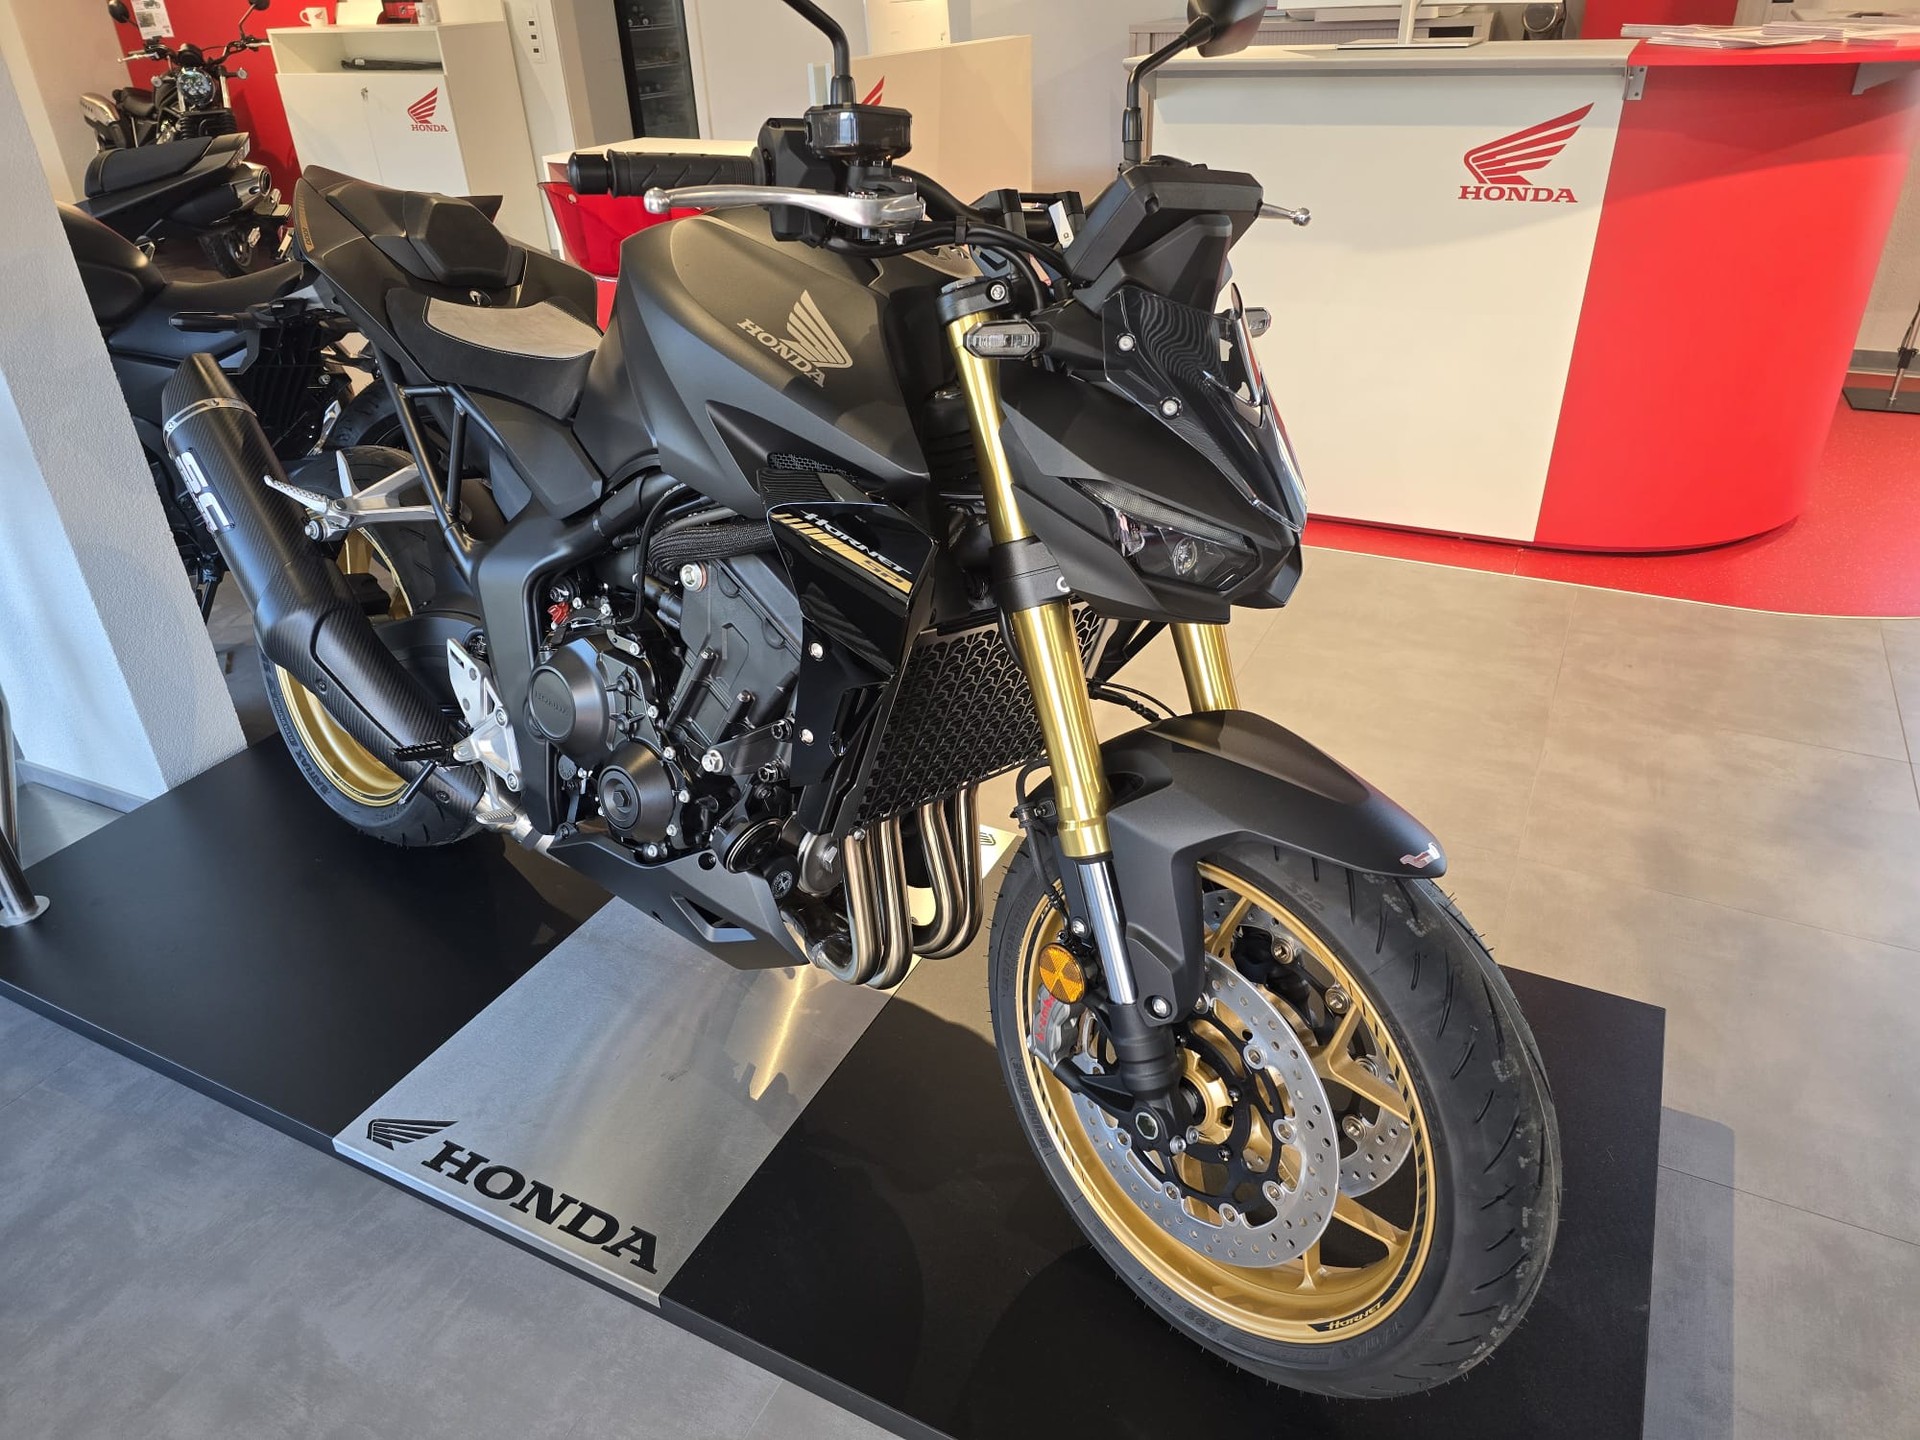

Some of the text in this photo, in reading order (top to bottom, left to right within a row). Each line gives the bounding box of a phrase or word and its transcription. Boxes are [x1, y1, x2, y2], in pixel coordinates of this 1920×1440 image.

[411, 124, 449, 132] HONDA
[1458, 185, 1579, 203] HONDA
[736, 318, 826, 388] HONDA
[421, 1140, 658, 1275] HONDA
